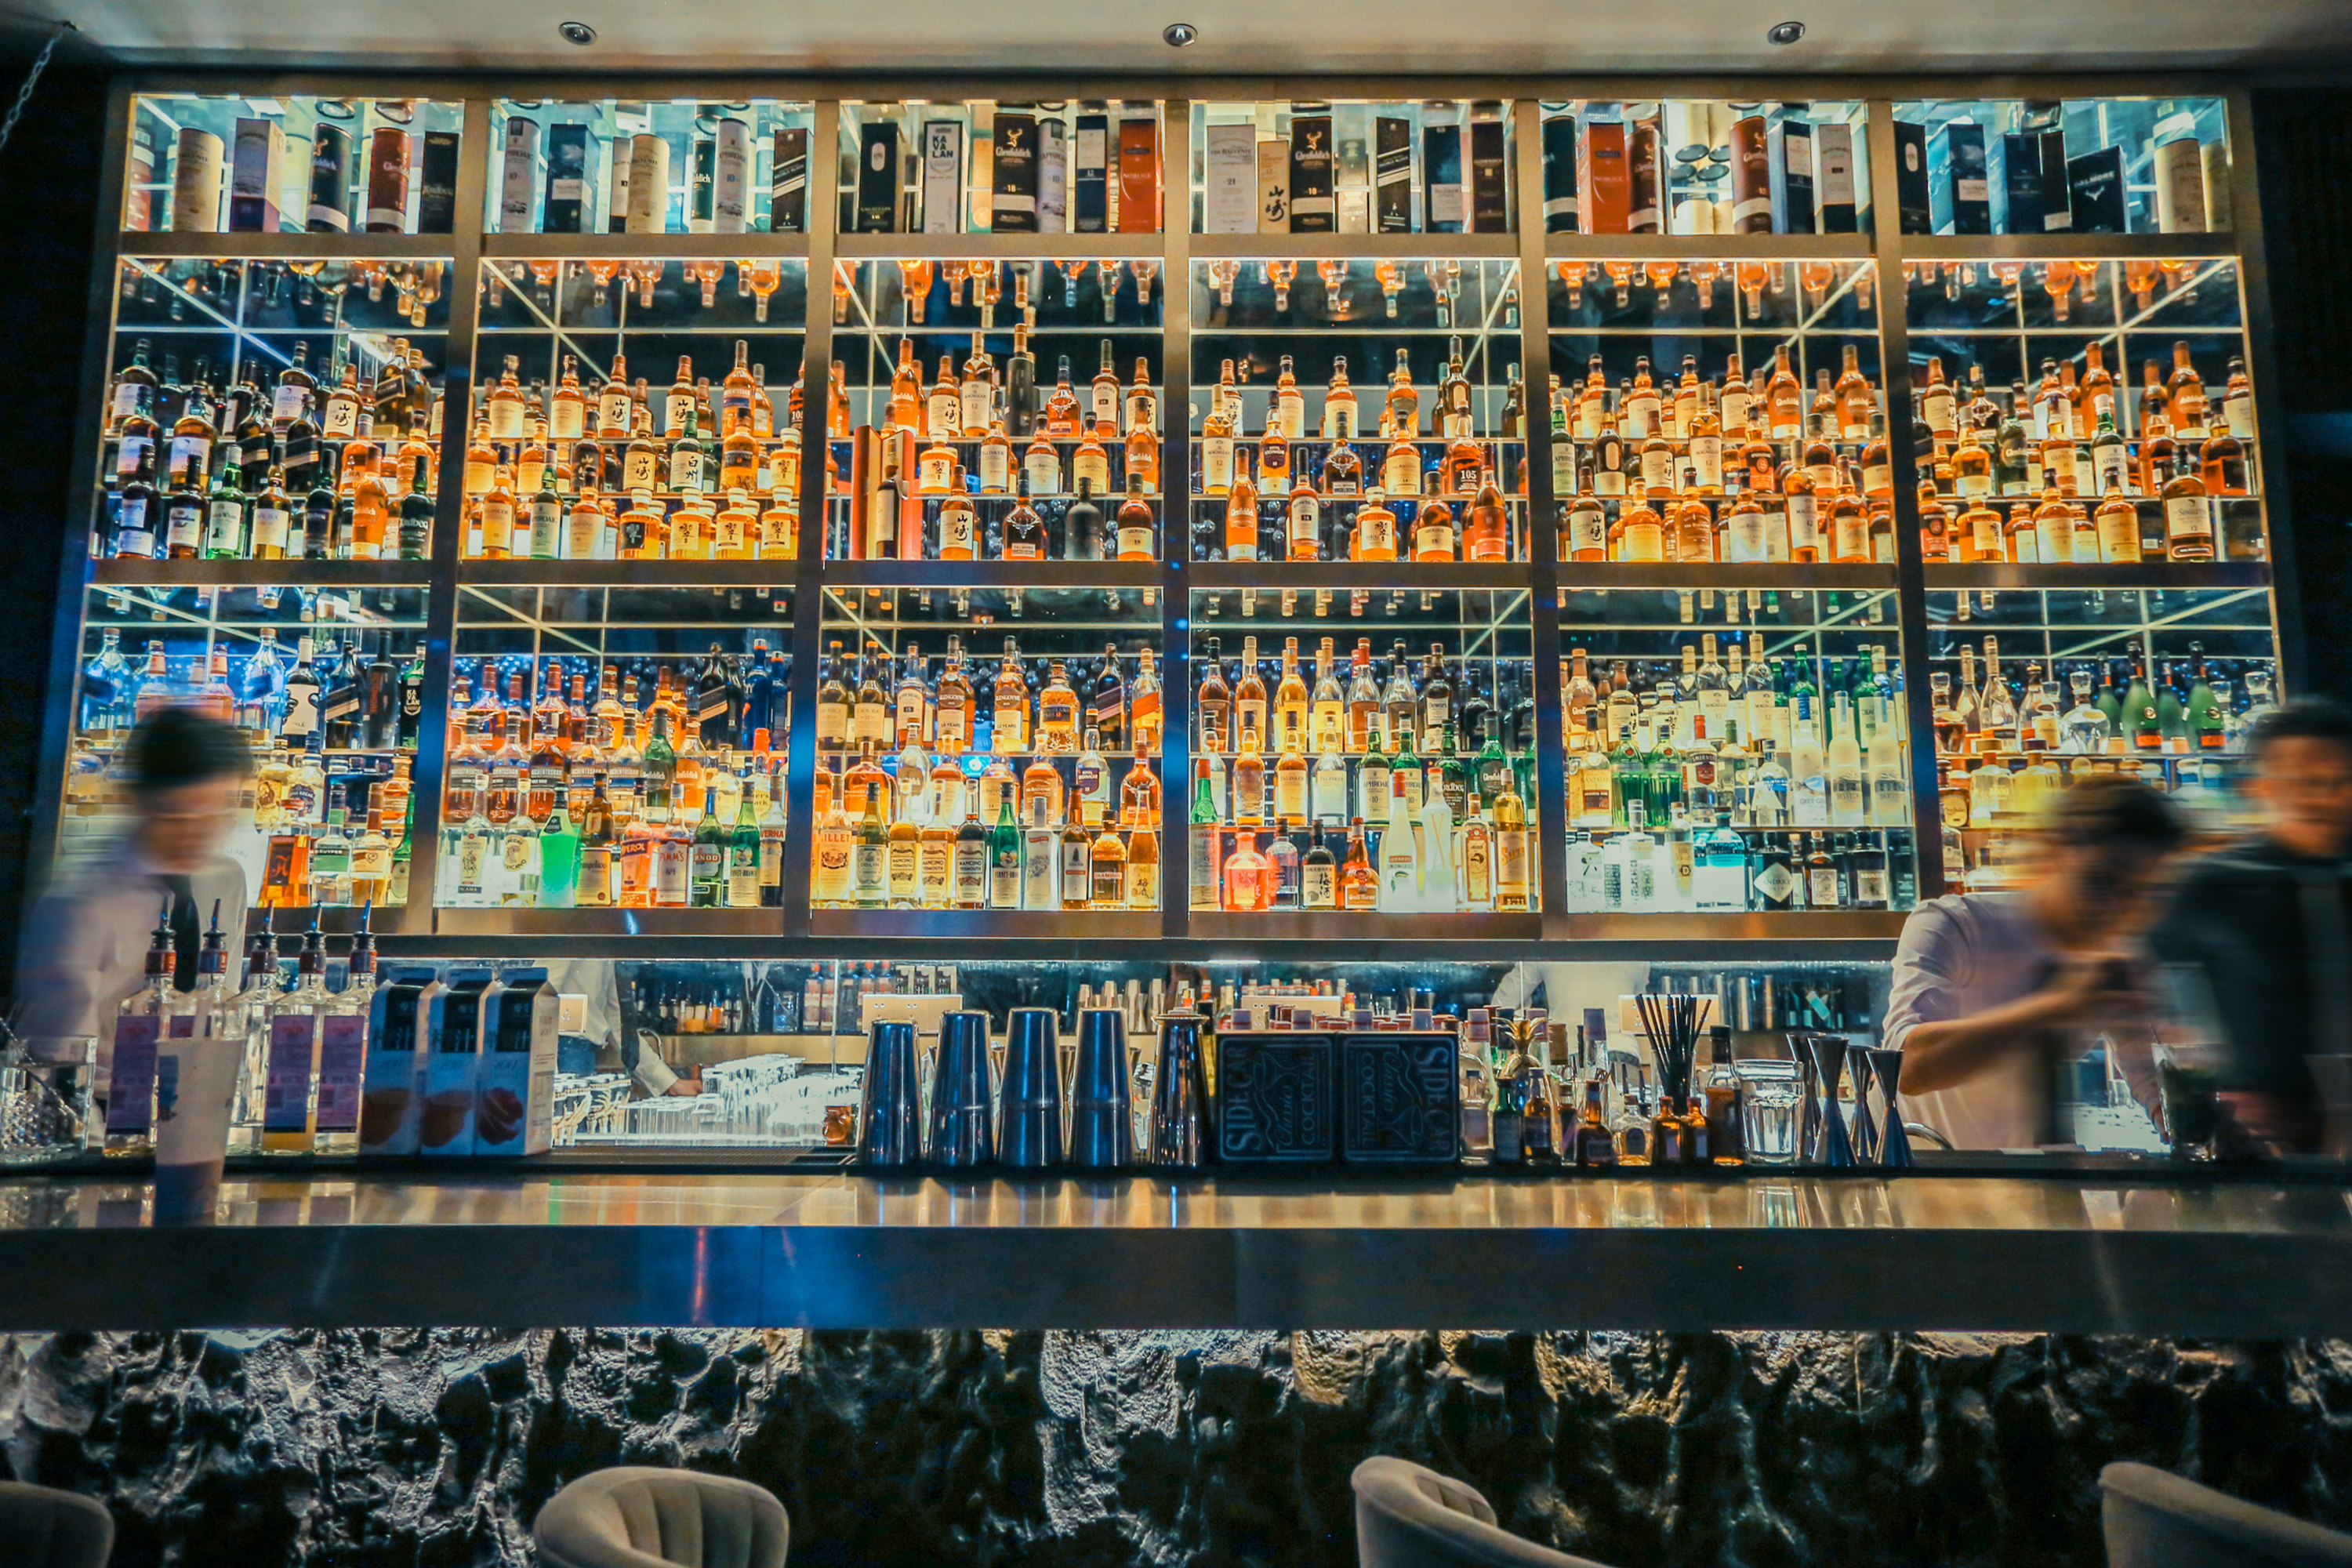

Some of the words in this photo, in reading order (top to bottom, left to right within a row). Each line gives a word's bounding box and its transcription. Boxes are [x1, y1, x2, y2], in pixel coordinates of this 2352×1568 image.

[996, 147, 1031, 157] Glenfiddich
[1295, 151, 1330, 161] Glenfiddich
[2074, 171, 2115, 189] DALMORE
[1265, 185, 1287, 222] 山崎
[336, 404, 351, 426] 山崎
[612, 398, 626, 423] 山崎
[945, 400, 957, 424] 山崎
[1129, 453, 1152, 462] Glenfiddich
[636, 458, 650, 481] 山崎
[686, 456, 699, 483] 白州
[1461, 470, 1477, 479] 105
[1230, 508, 1254, 517] Glenfiddich
[954, 514, 969, 541] 山崎
[1591, 515, 1602, 541] 山崎
[659, 852, 684, 862] PIMM'S
[694, 854, 719, 862] RNOD
[1301, 1051, 1315, 1145] COCKTAIL
[1361, 1053, 1375, 1145] COCKTAIL
